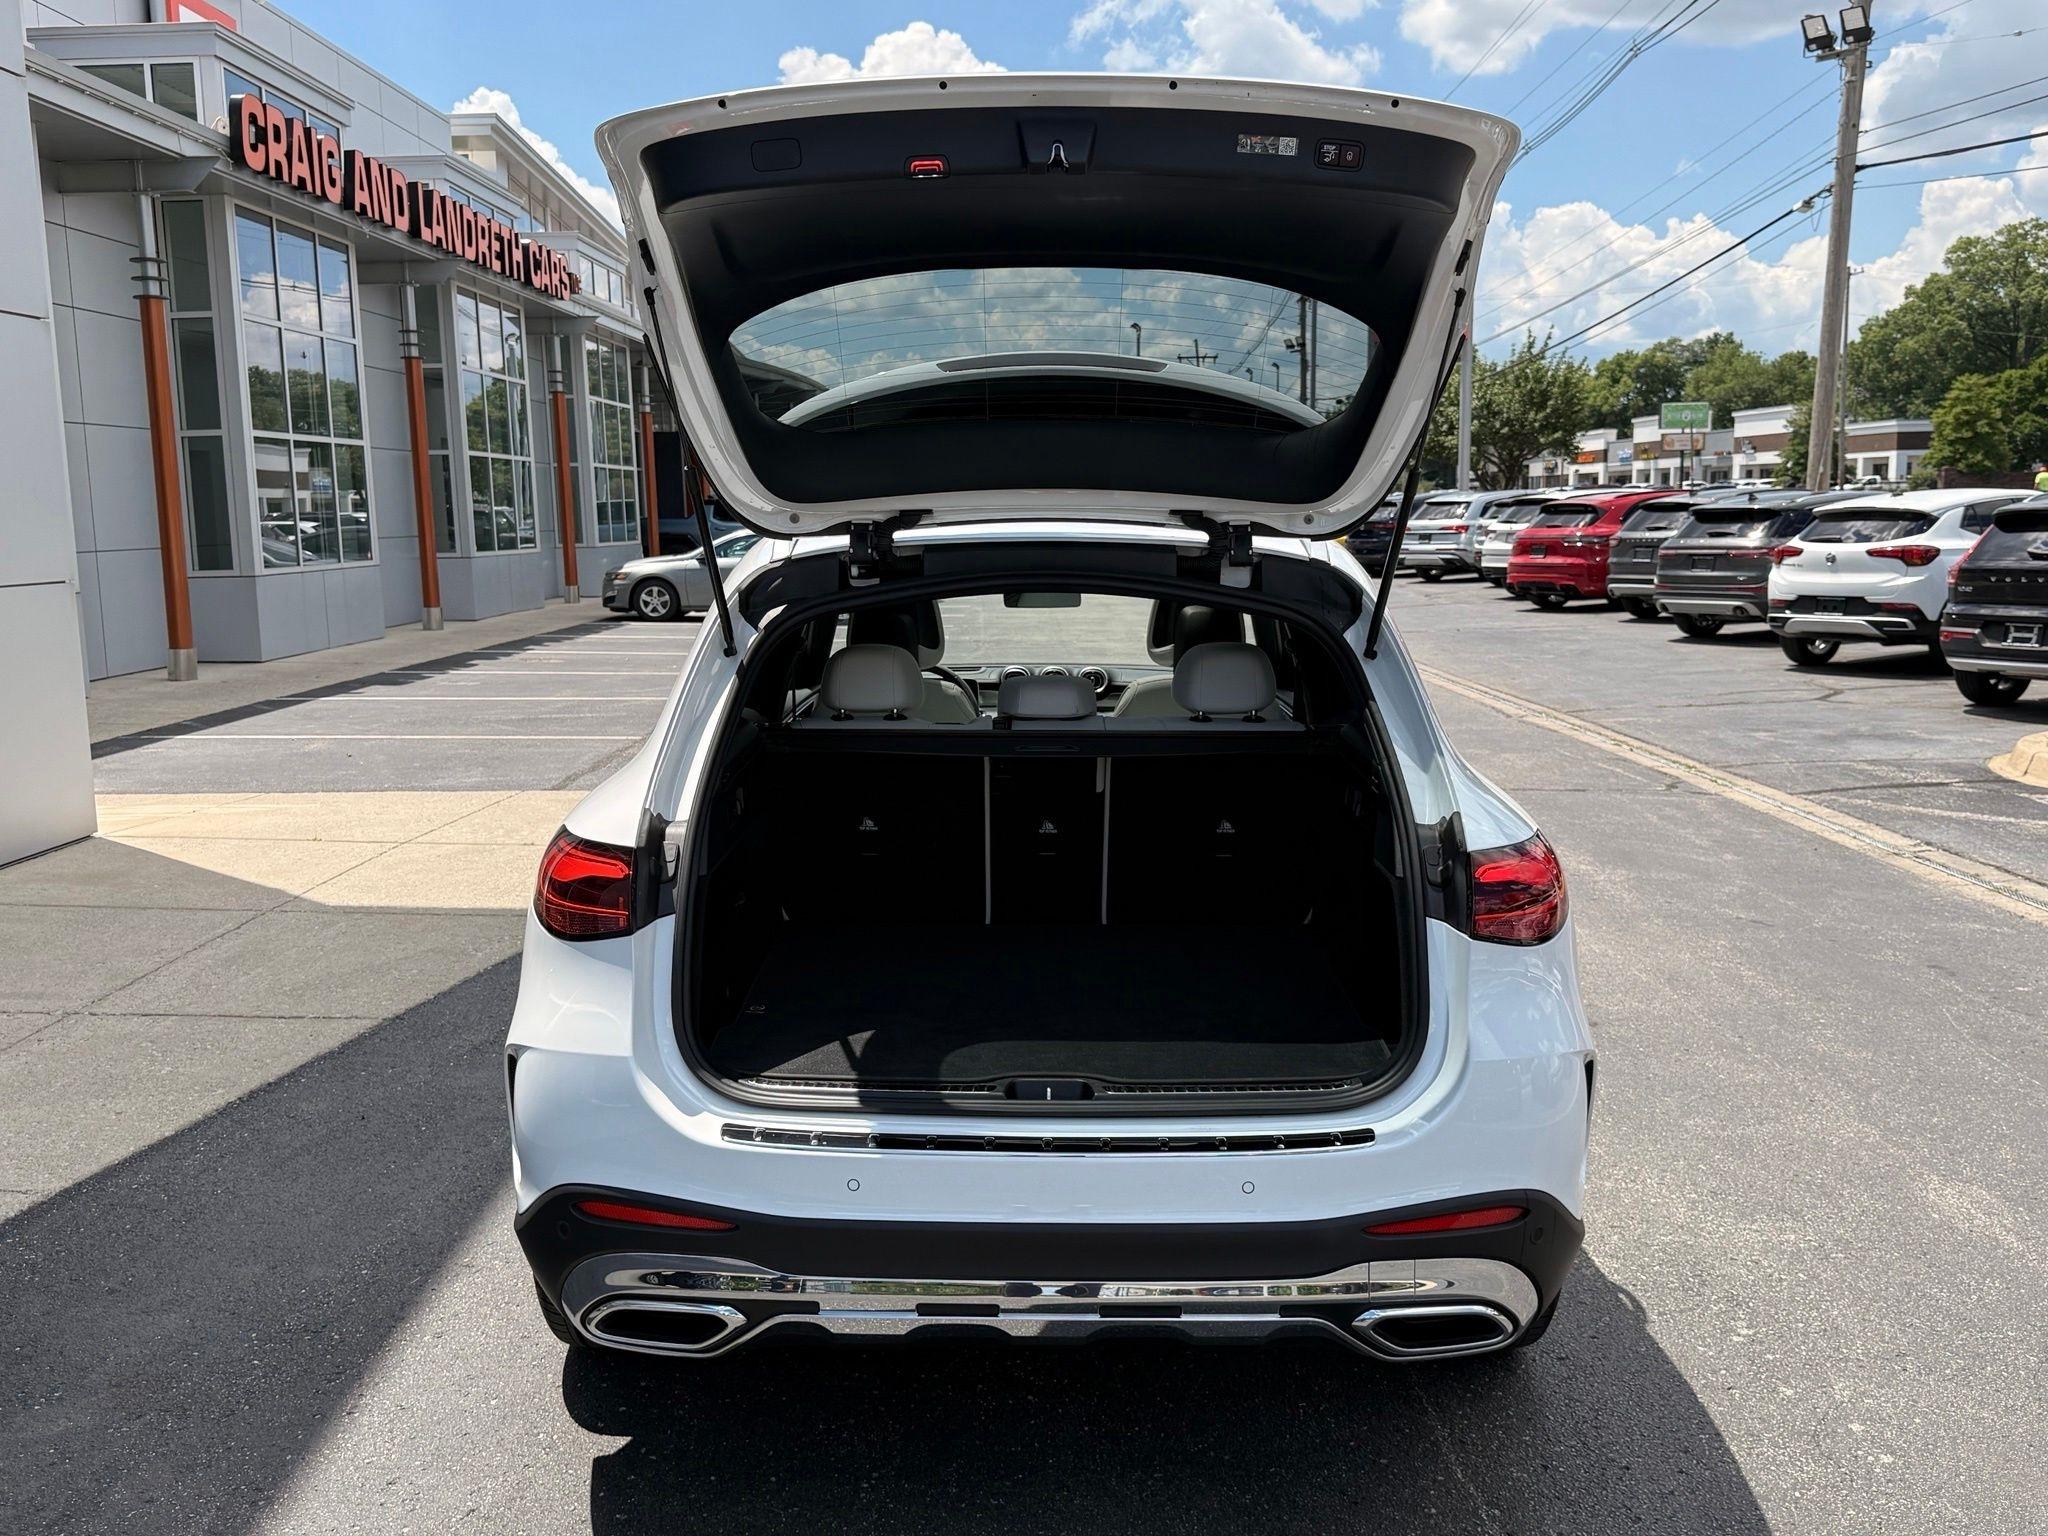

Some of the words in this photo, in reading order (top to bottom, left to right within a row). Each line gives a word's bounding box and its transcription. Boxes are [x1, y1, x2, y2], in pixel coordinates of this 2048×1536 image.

[240, 93, 342, 204] CRAIG
[353, 150, 411, 233] AND
[418, 187, 525, 283] LANDRETH
[528, 239, 571, 301] CARS
